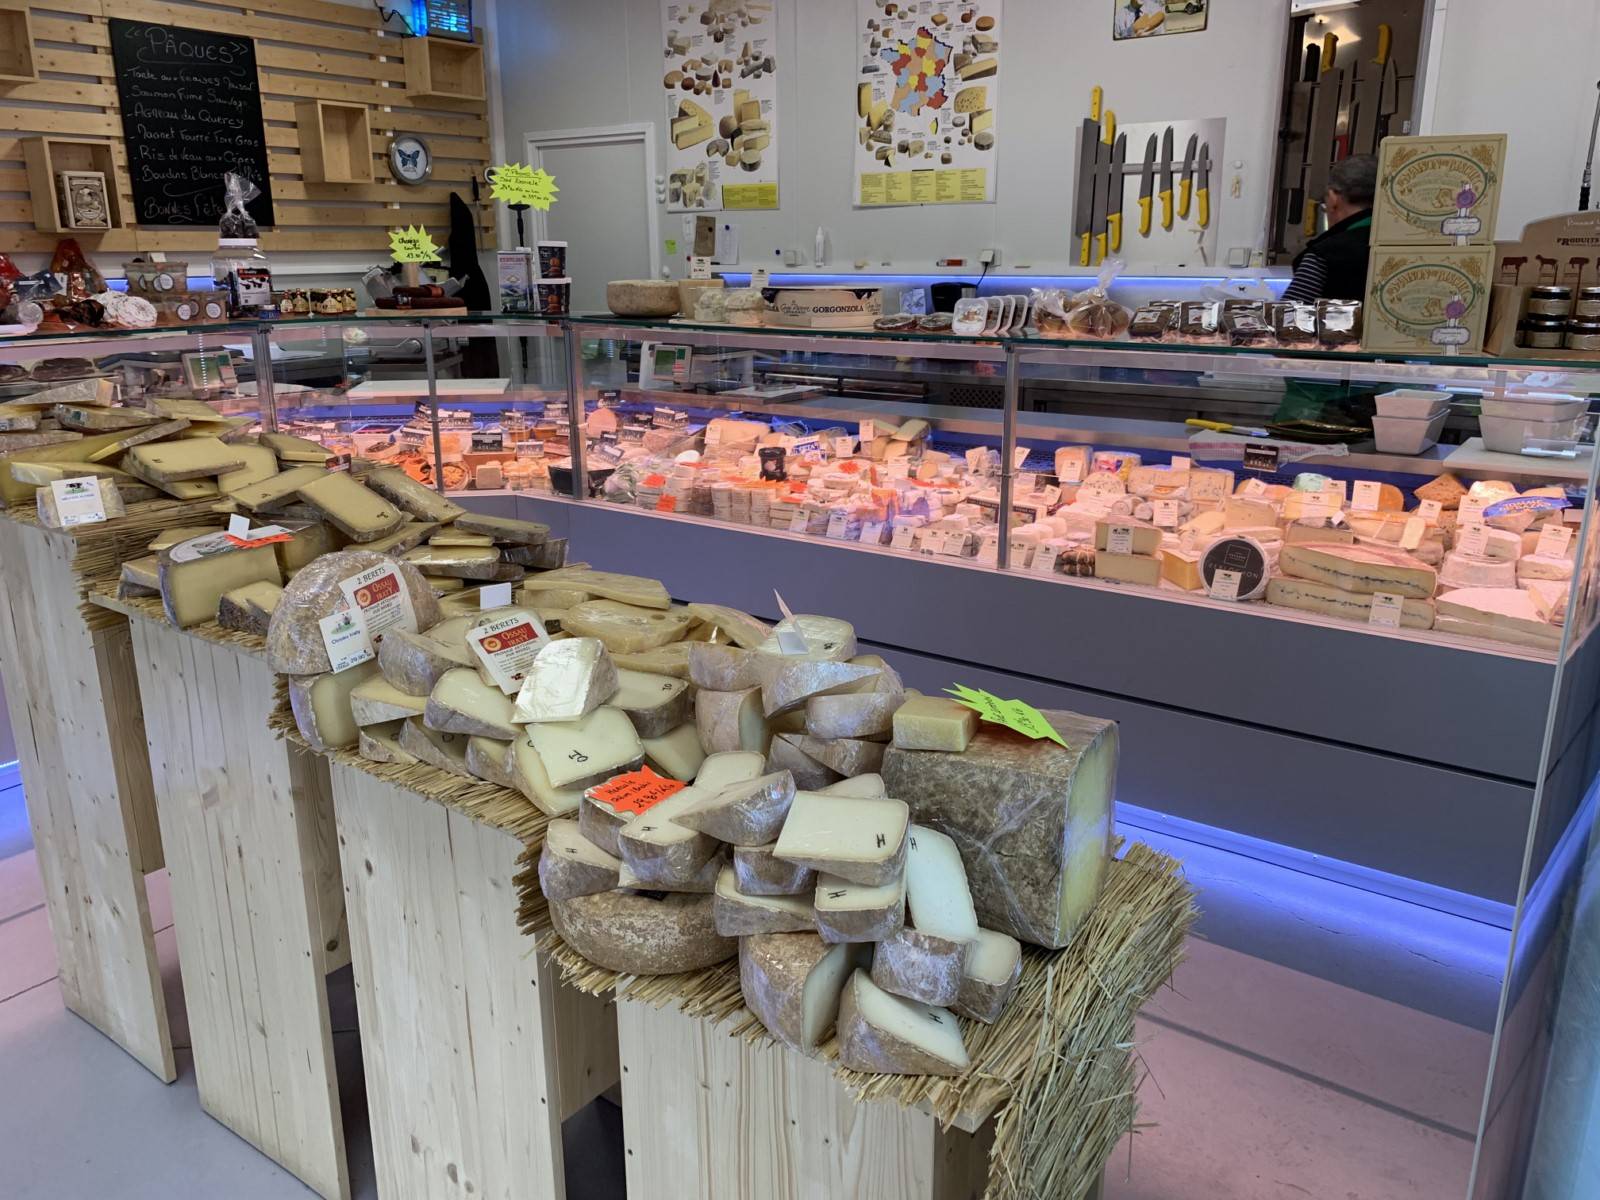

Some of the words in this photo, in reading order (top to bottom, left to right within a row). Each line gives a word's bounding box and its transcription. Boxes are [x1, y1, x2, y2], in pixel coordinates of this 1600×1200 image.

[812, 305, 864, 314] GORGONZOLA
[363, 567, 386, 582] BERETS
[490, 617, 520, 632] BERETS
